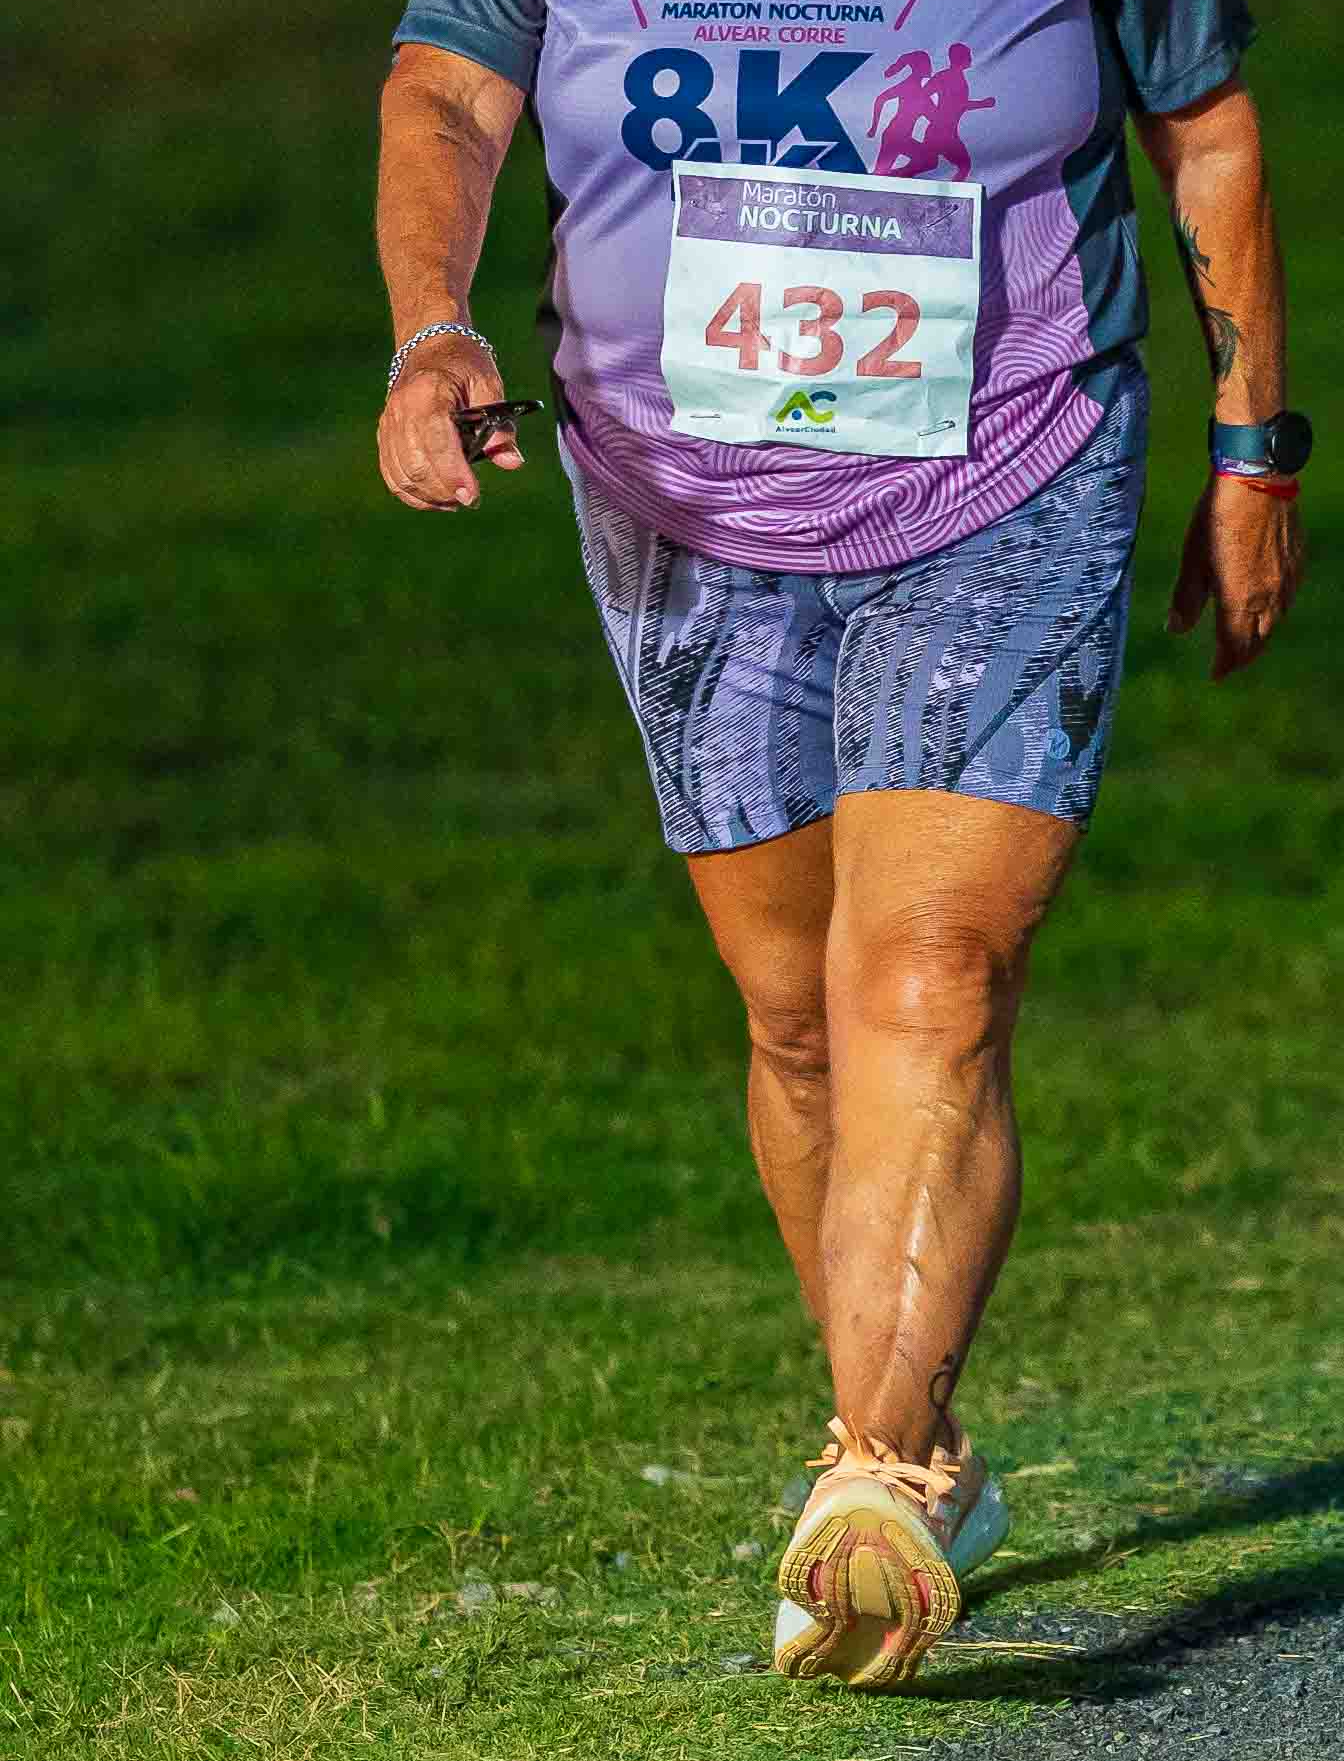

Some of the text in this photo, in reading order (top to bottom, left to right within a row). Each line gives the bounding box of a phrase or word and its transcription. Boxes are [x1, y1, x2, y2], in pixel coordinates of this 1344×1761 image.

[661, 1, 885, 23] MARATON NOCTURNA
[693, 25, 847, 44] ALVEAR CORRE
[621, 47, 877, 175] 8K
[742, 182, 837, 209] Maratón
[738, 206, 904, 240] NOCTURNA
[705, 281, 923, 379] 432
